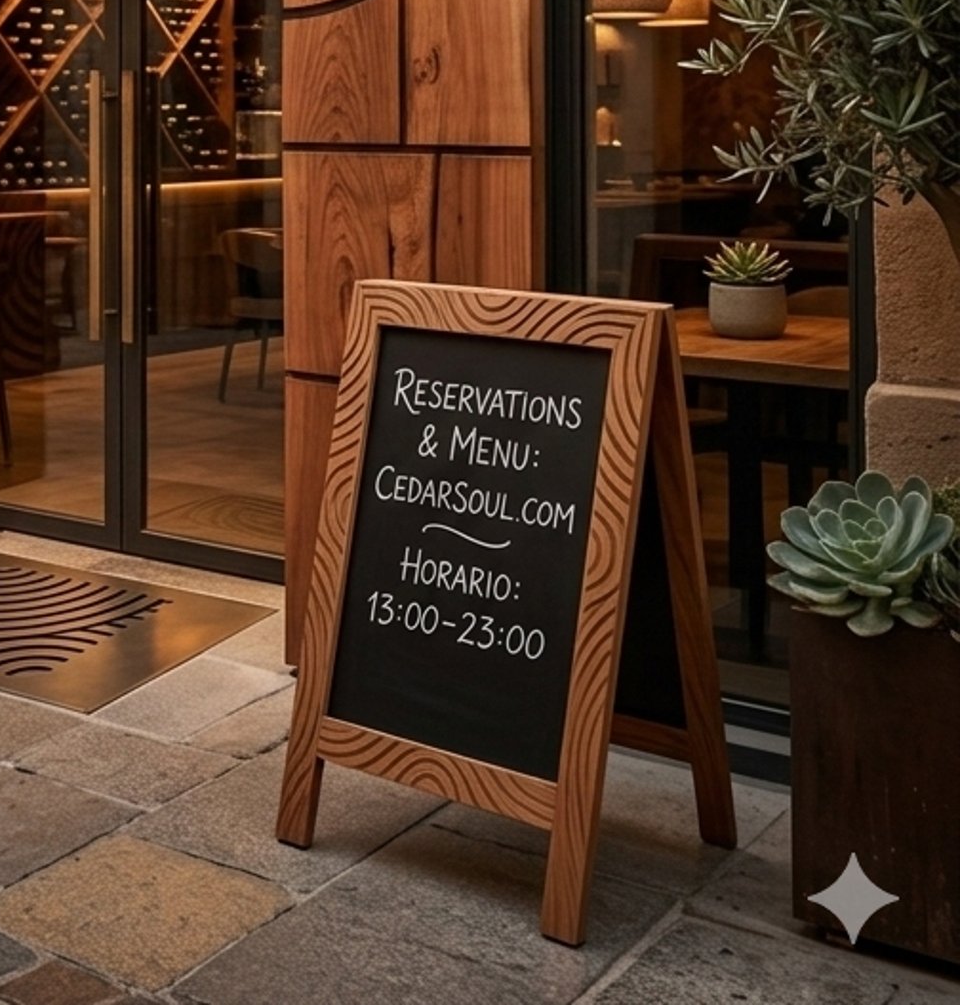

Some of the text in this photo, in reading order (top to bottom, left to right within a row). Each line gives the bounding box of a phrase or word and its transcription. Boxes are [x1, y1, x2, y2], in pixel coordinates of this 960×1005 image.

[394, 367, 582, 429] RESERVATIONS
[418, 423, 541, 471] & MENU:
[400, 546, 522, 601] HORARIO:
